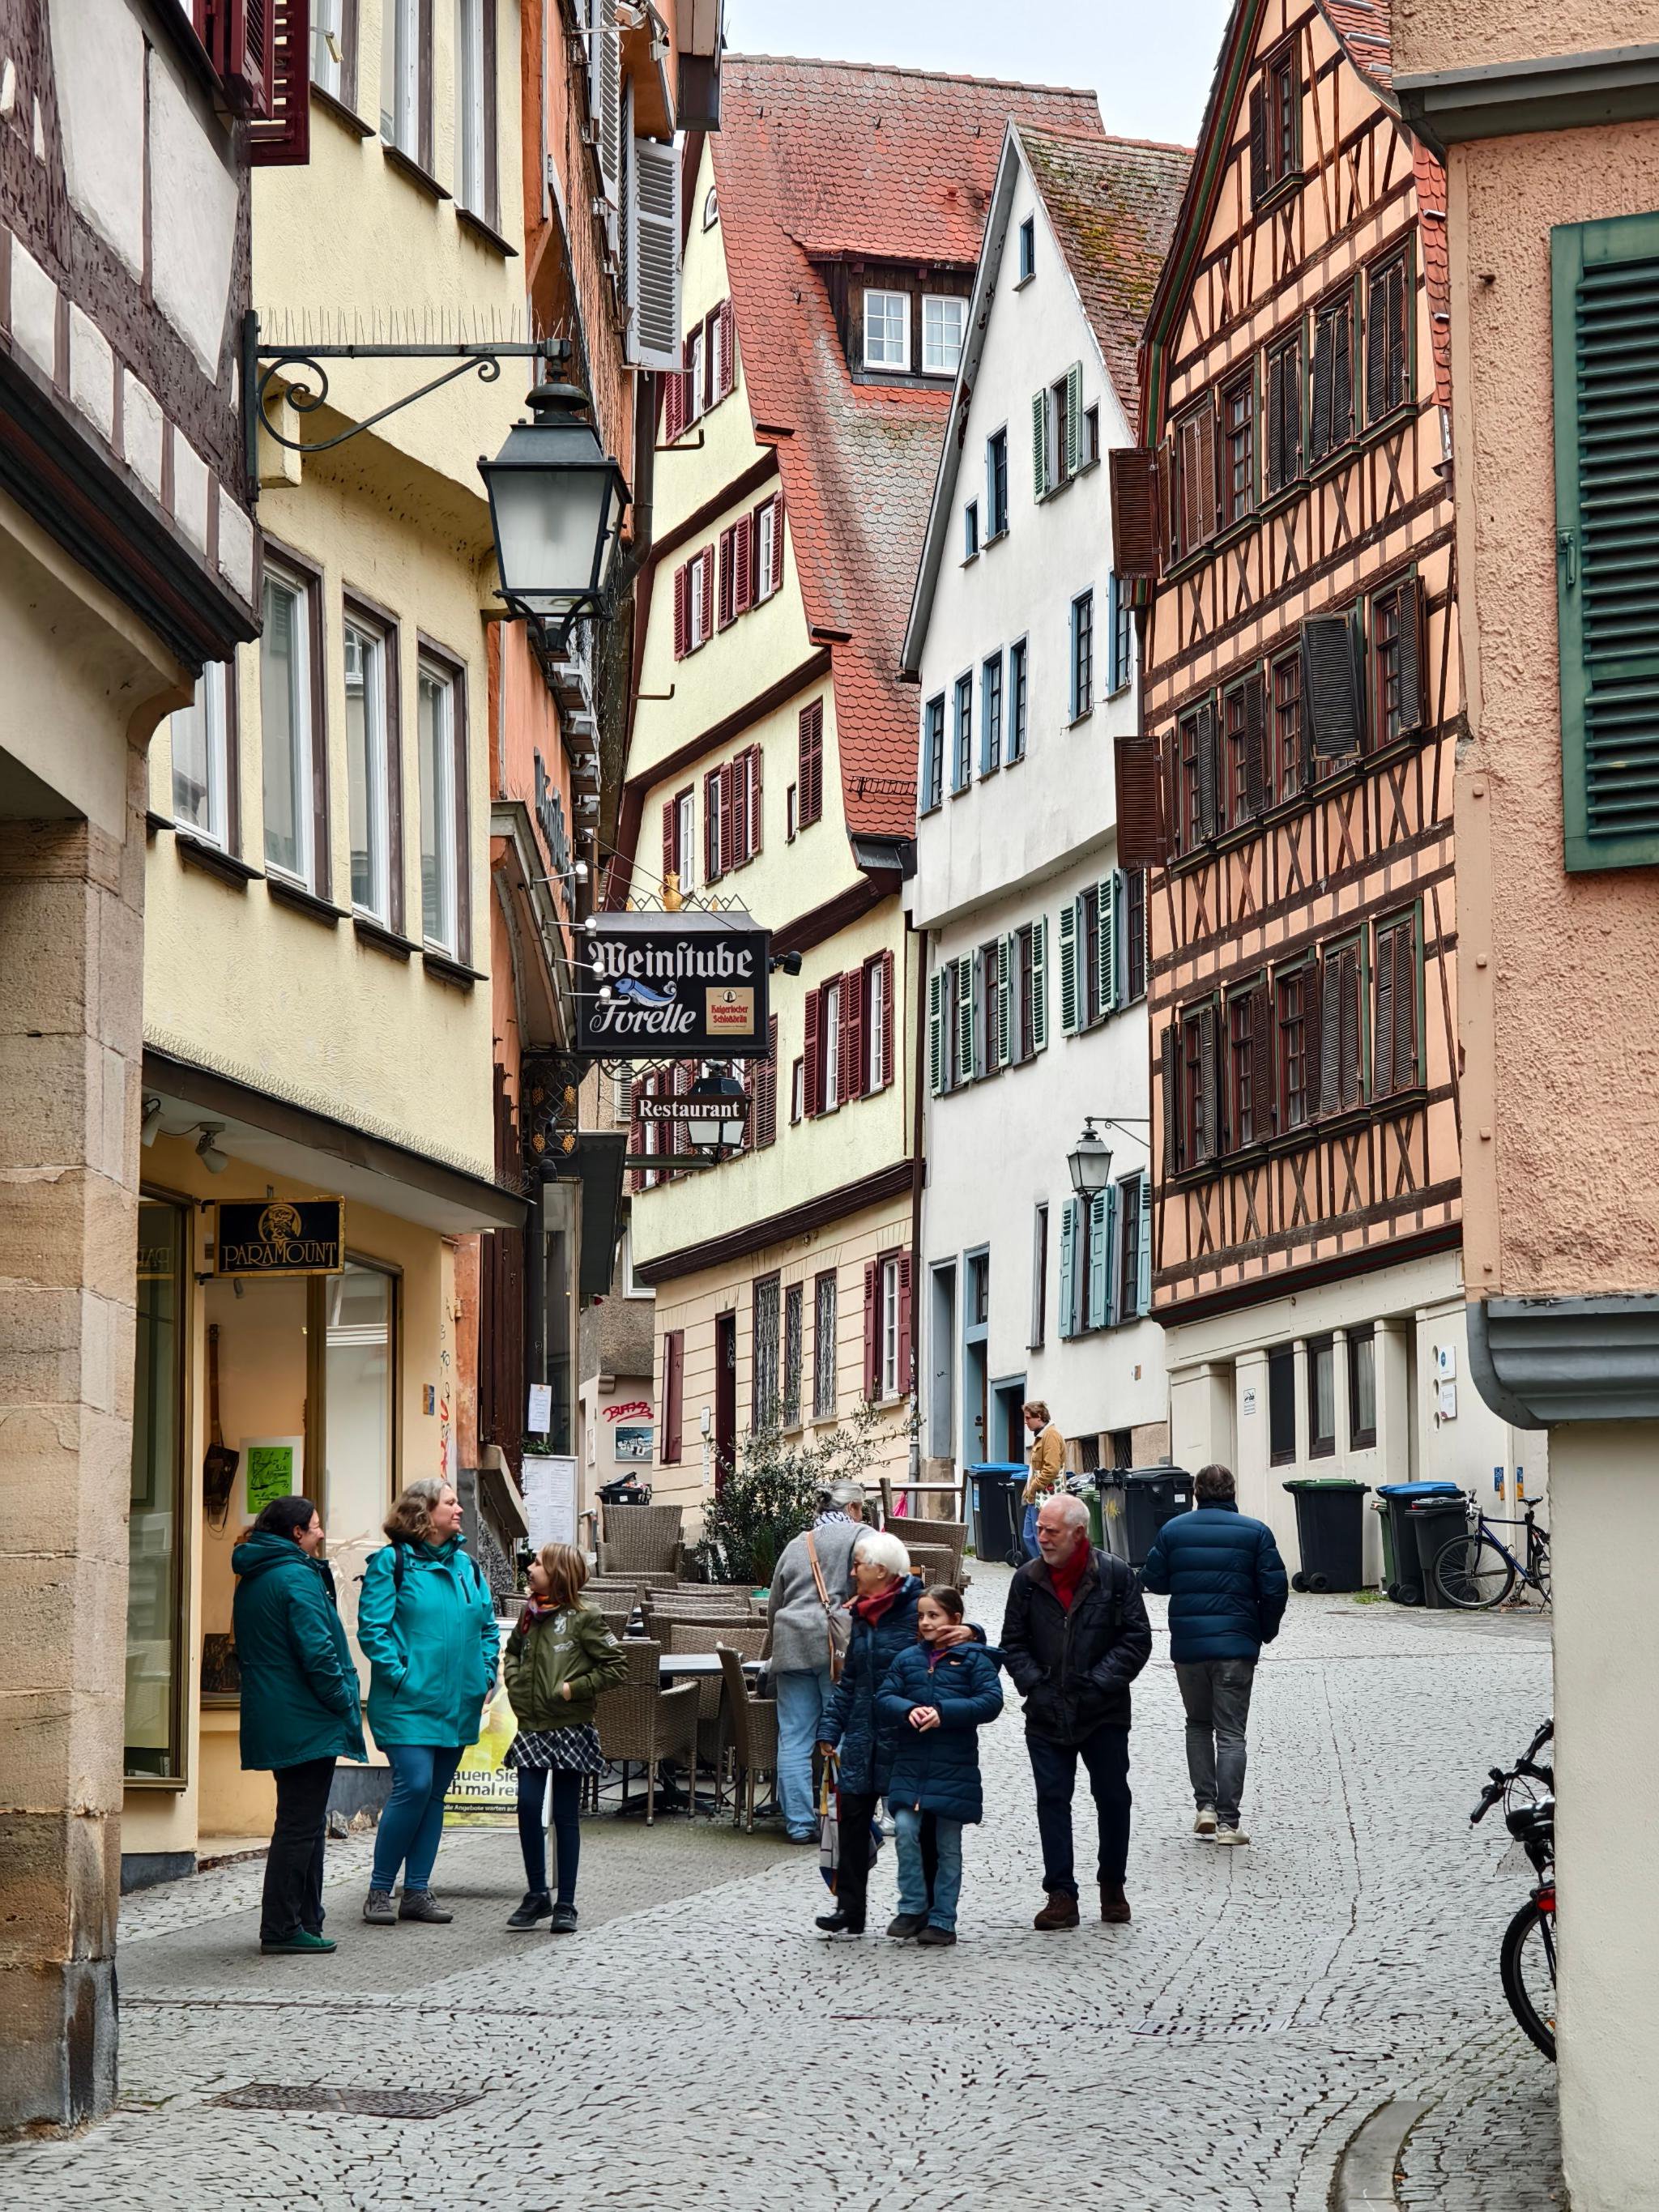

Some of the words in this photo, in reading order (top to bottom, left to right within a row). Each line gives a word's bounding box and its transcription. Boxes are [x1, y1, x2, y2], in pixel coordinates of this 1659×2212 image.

[589, 995, 697, 1034] Forelle
[638, 1099, 740, 1118] Restaurant
[222, 1240, 337, 1272] PARAMOUNT
[495, 1768, 518, 1782] Sie
[466, 1782, 495, 1796] mal
